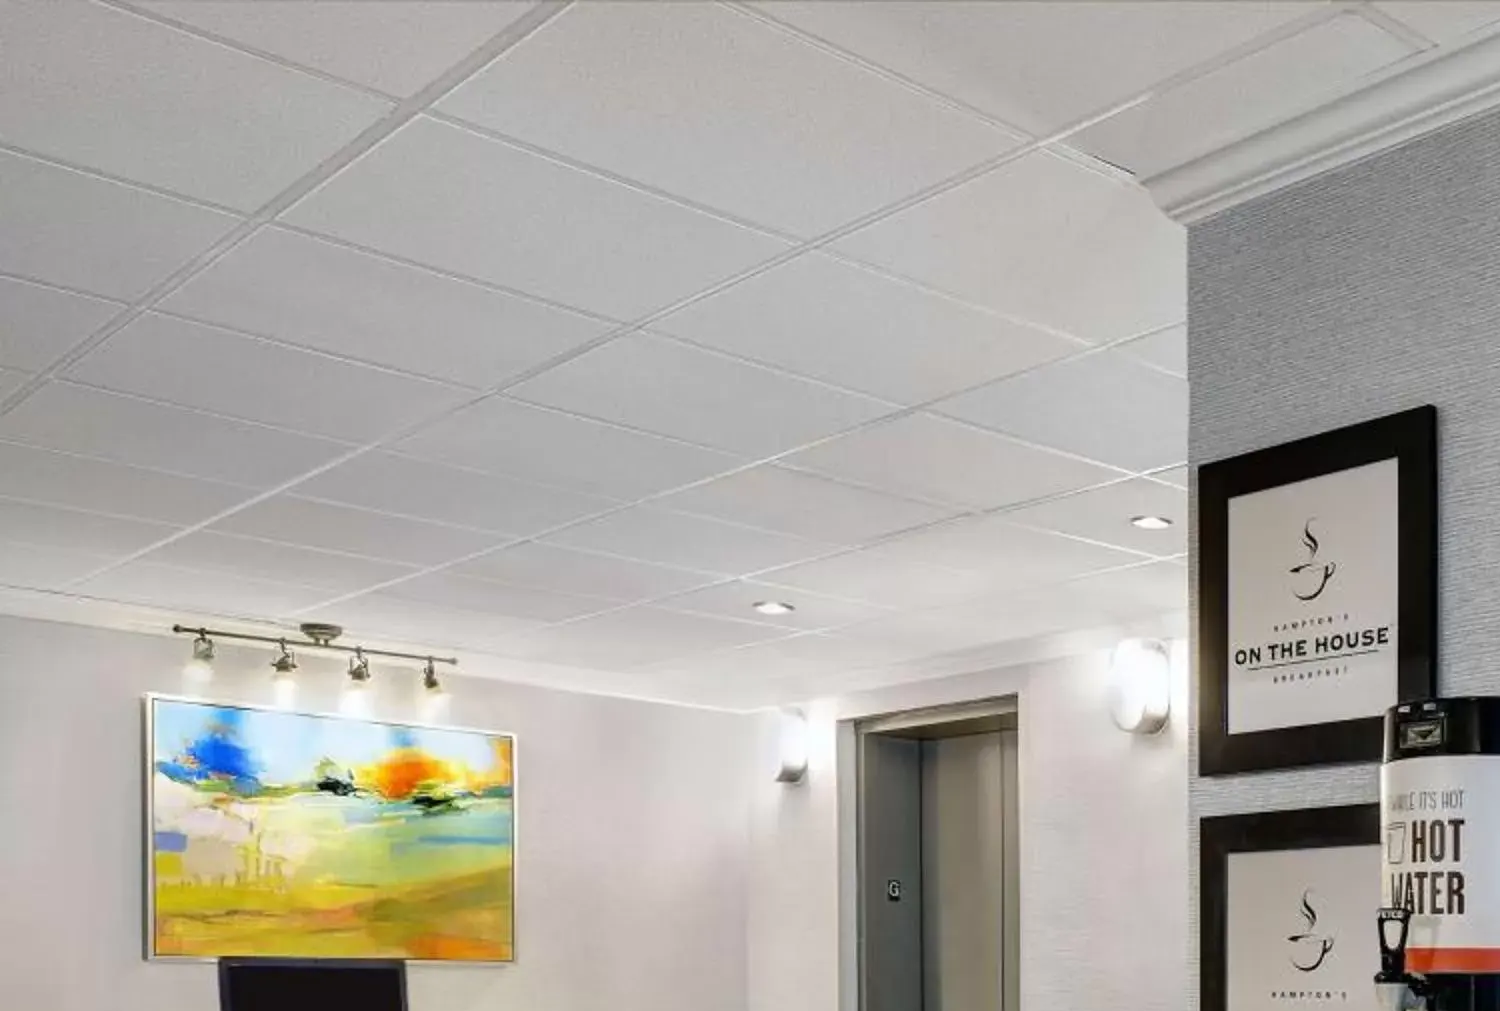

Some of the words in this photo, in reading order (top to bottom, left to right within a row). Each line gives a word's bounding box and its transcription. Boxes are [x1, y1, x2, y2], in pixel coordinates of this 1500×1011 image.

[1235, 648, 1261, 665] ON
[1268, 640, 1307, 660] THE
[1315, 627, 1389, 654] HOUSE
[1441, 790, 1465, 810] HOT
[1412, 818, 1465, 863] HOT
[889, 881, 900, 897] G
[1391, 872, 1465, 914] WATER
